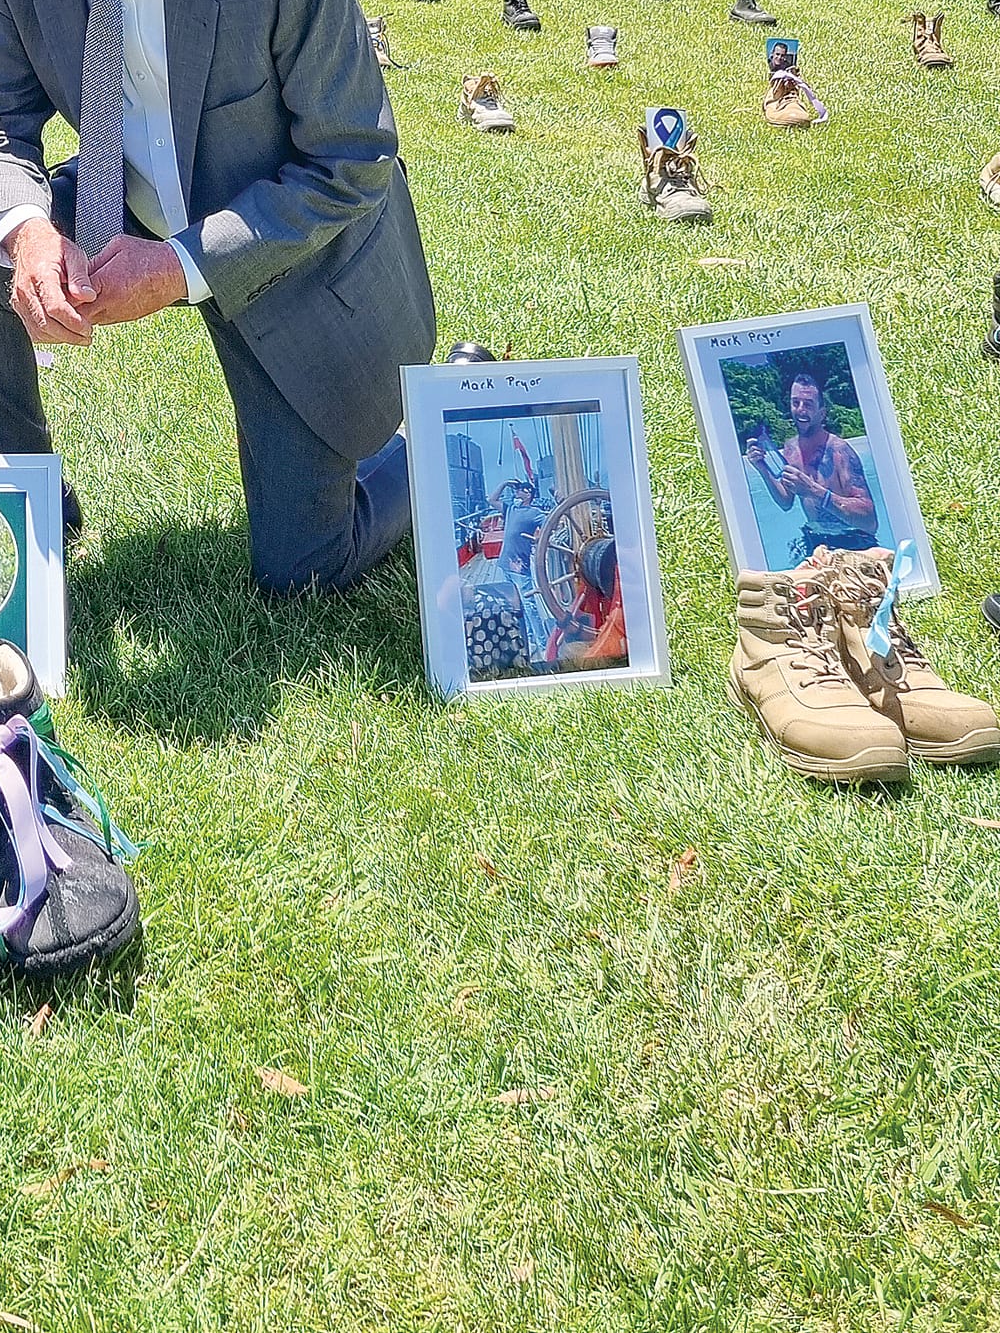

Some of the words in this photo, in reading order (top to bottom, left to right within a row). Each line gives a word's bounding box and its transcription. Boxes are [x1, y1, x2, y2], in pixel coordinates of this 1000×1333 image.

[709, 335, 742, 348] Mark
[748, 329, 782, 345] Pryor
[460, 377, 494, 391] Mark
[506, 375, 542, 392] Pryor
